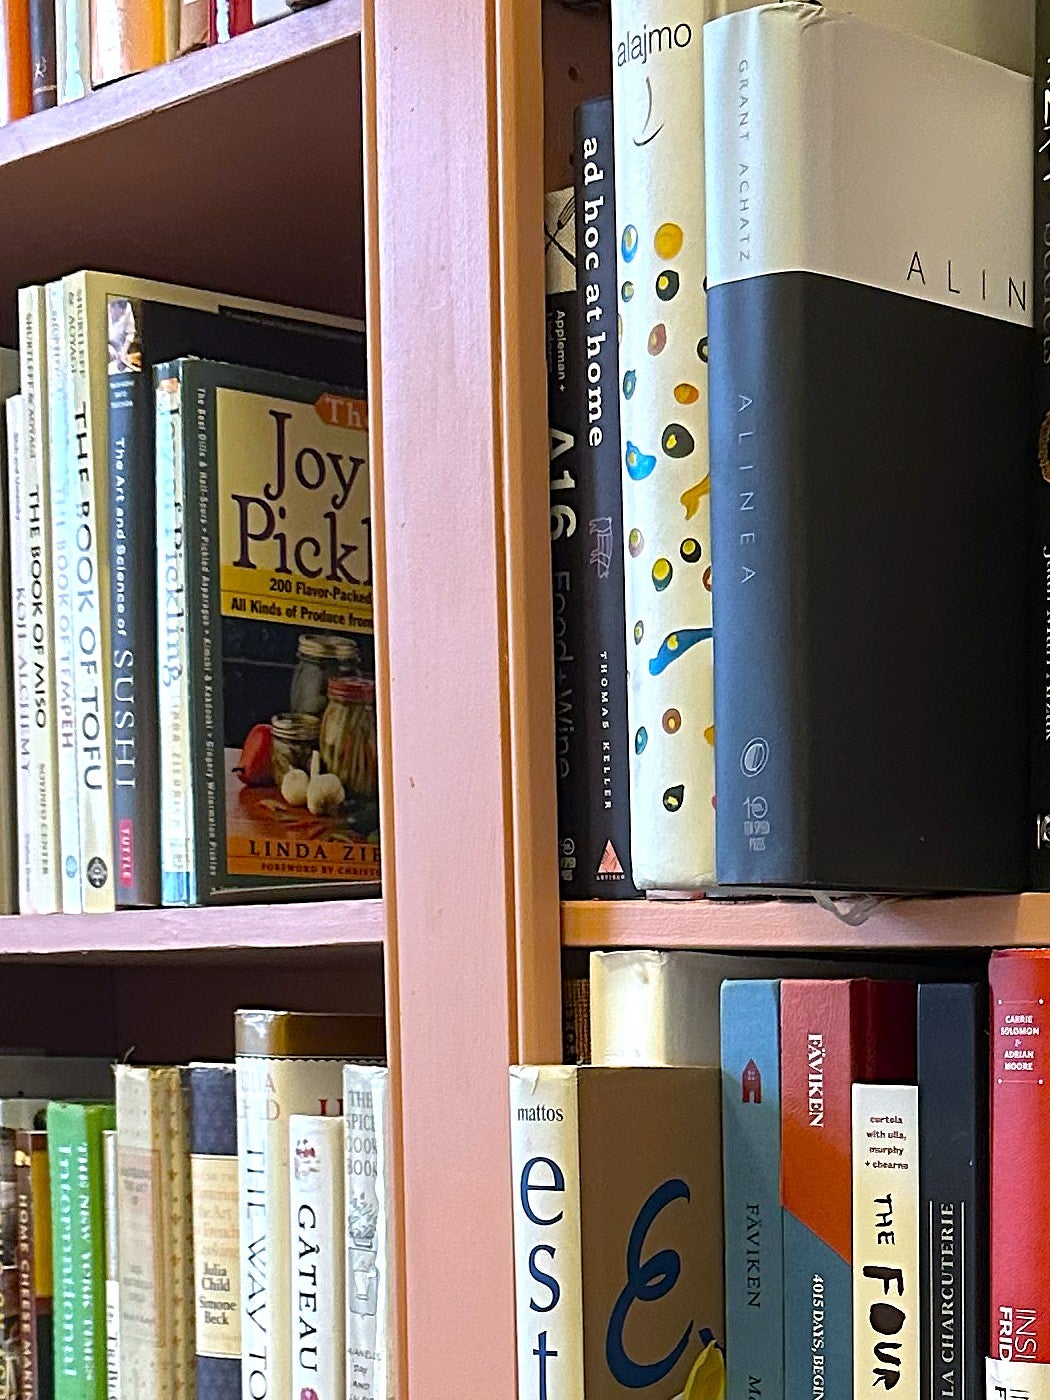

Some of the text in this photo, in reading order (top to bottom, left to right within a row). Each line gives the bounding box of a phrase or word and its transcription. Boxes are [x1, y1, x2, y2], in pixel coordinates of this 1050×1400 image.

[617, 21, 692, 67] alajmo
[738, 59, 751, 262] GRANT ACHATZ
[583, 137, 604, 447] ad hoc at home
[264, 409, 366, 510] Joy
[738, 395, 756, 583] ALINEA
[231, 597, 346, 625] All Kinds of Produce
[81, 687, 102, 790] TOFU
[114, 650, 135, 787] SUSHI
[599, 651, 612, 810] THOMAS KELLER
[249, 839, 328, 860] LINDA
[517, 1103, 564, 1122] mattos
[808, 1033, 824, 1128] FÄVIKEN
[873, 1194, 895, 1246] THE
[247, 1235, 266, 1333] WAY
[297, 1204, 320, 1372] GÂTEAU
[862, 1265, 906, 1391] FOUR
[941, 1204, 955, 1362] CHARCUTERIE
[249, 1346, 267, 1400] TO
[942, 1370, 954, 1397] LA
